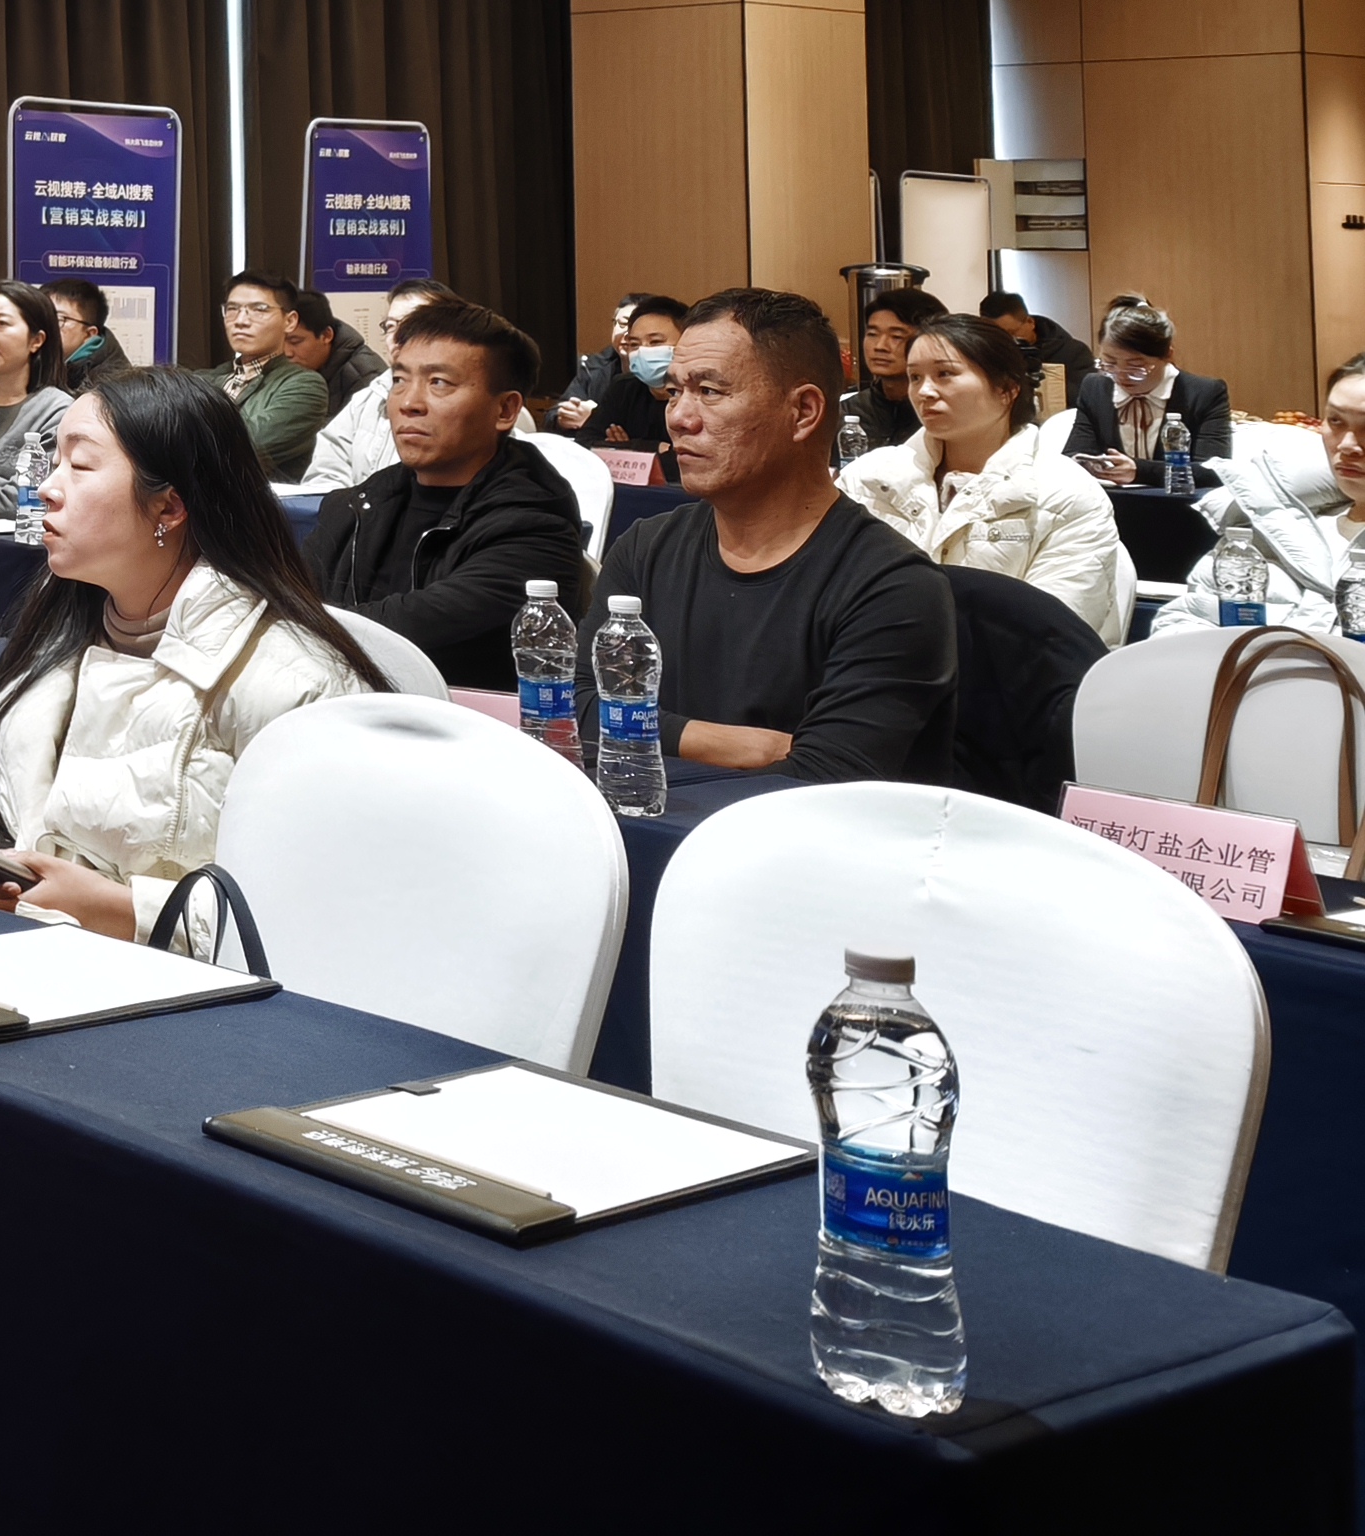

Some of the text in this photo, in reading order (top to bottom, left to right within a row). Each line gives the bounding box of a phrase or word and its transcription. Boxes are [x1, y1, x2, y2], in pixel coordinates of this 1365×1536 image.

[41, 206, 146, 228] 【营销实战案例】
[48, 254, 138, 270] 智能环保设备制造行业
[1162, 865, 1267, 910] 限公司
[864, 1186, 948, 1212] AQUAFINA
